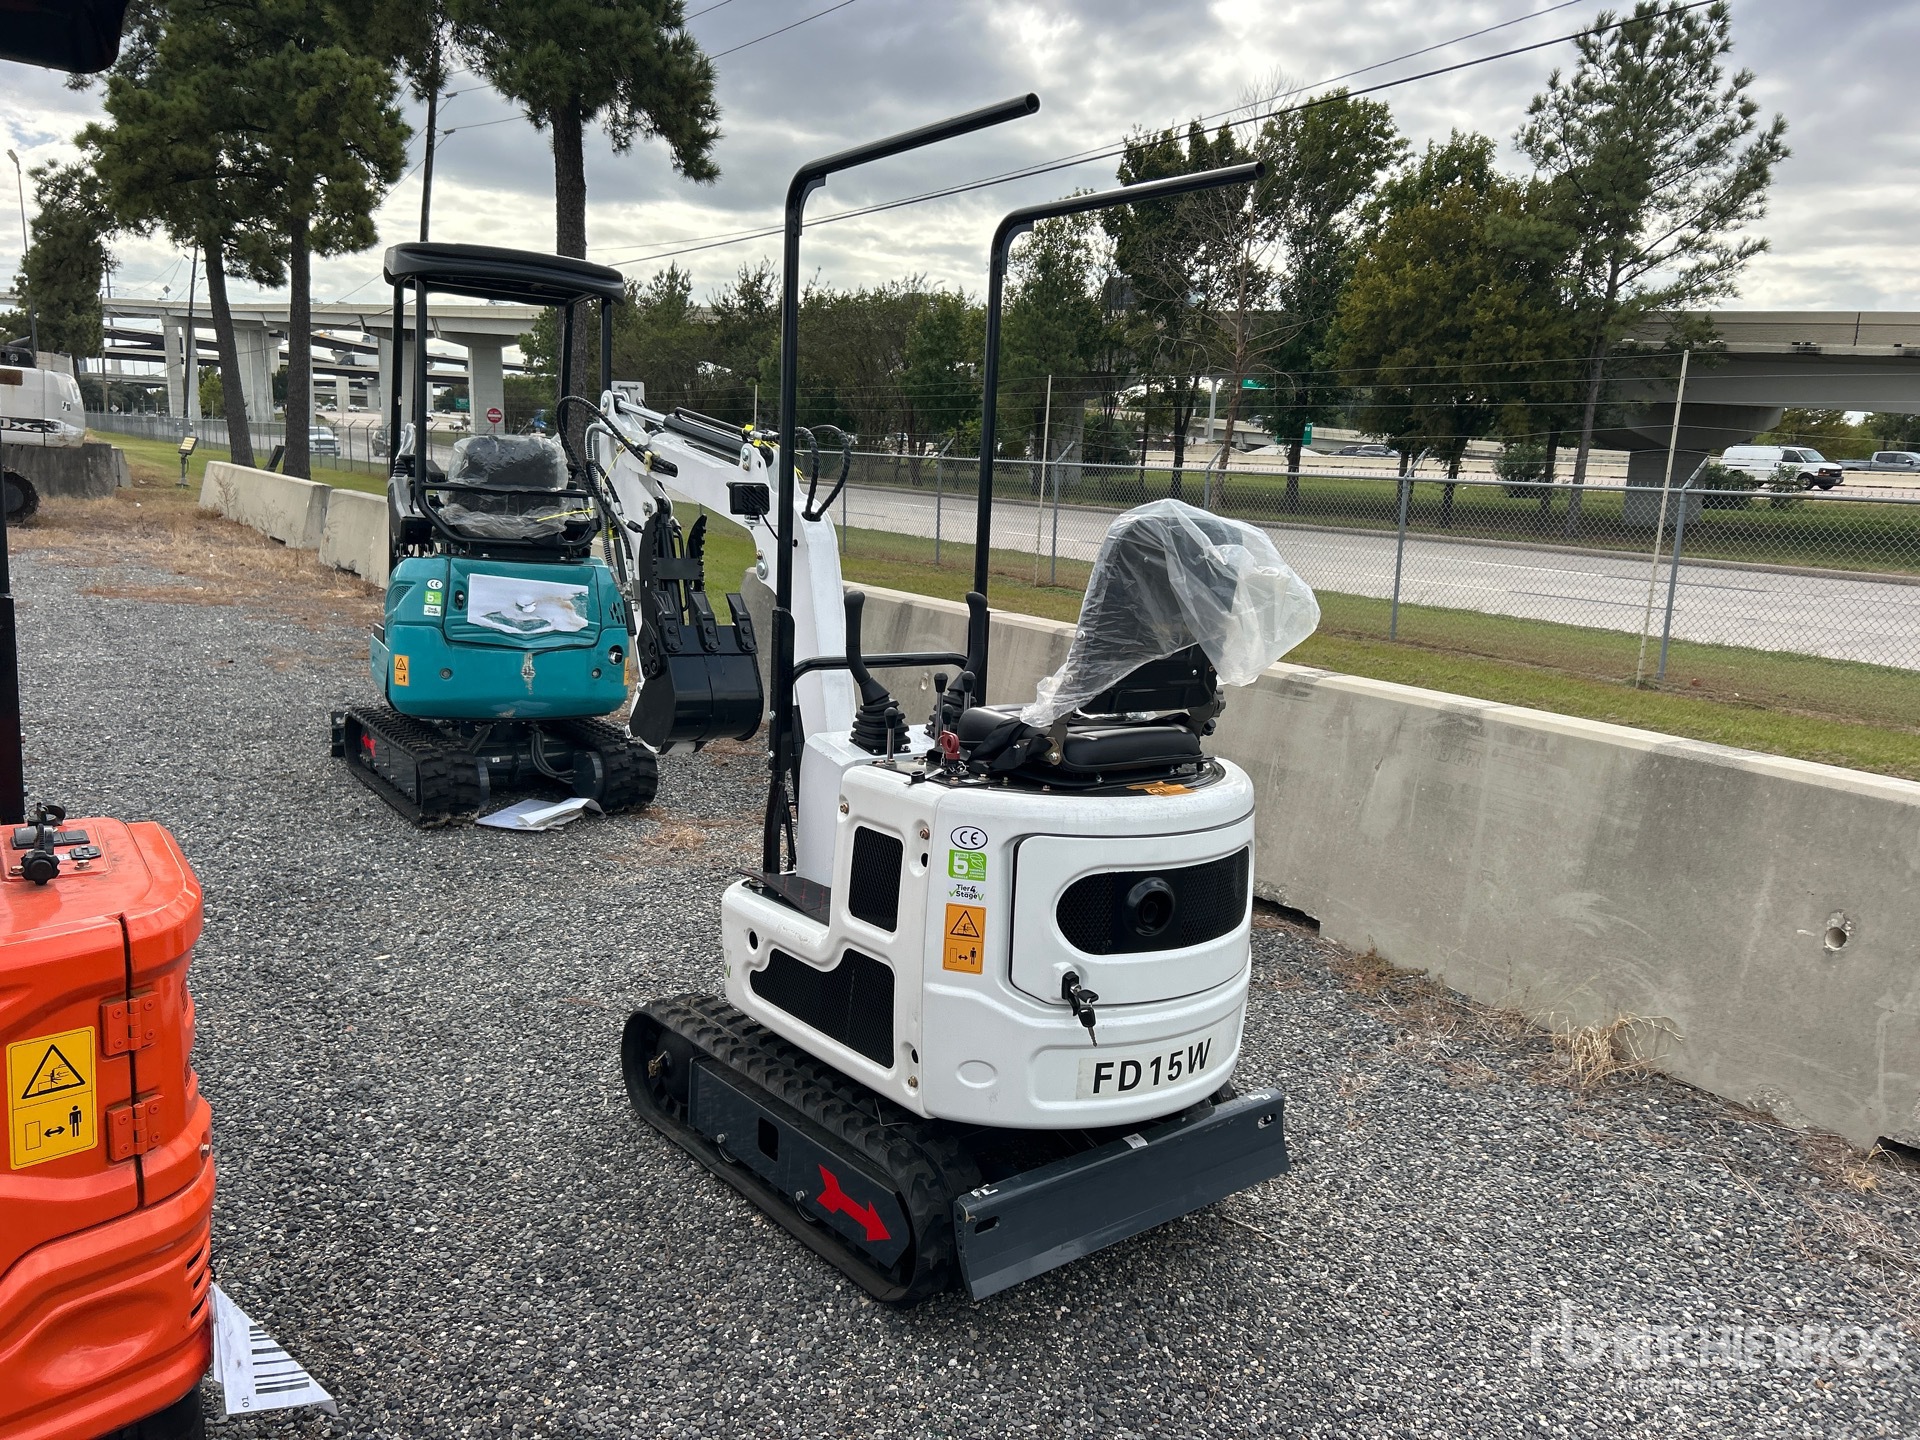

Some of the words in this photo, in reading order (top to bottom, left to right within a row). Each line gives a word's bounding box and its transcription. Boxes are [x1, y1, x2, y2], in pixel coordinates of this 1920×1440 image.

[960, 831, 979, 846] CE
[953, 852, 969, 875] 5
[1093, 1037, 1212, 1094] FD15W
